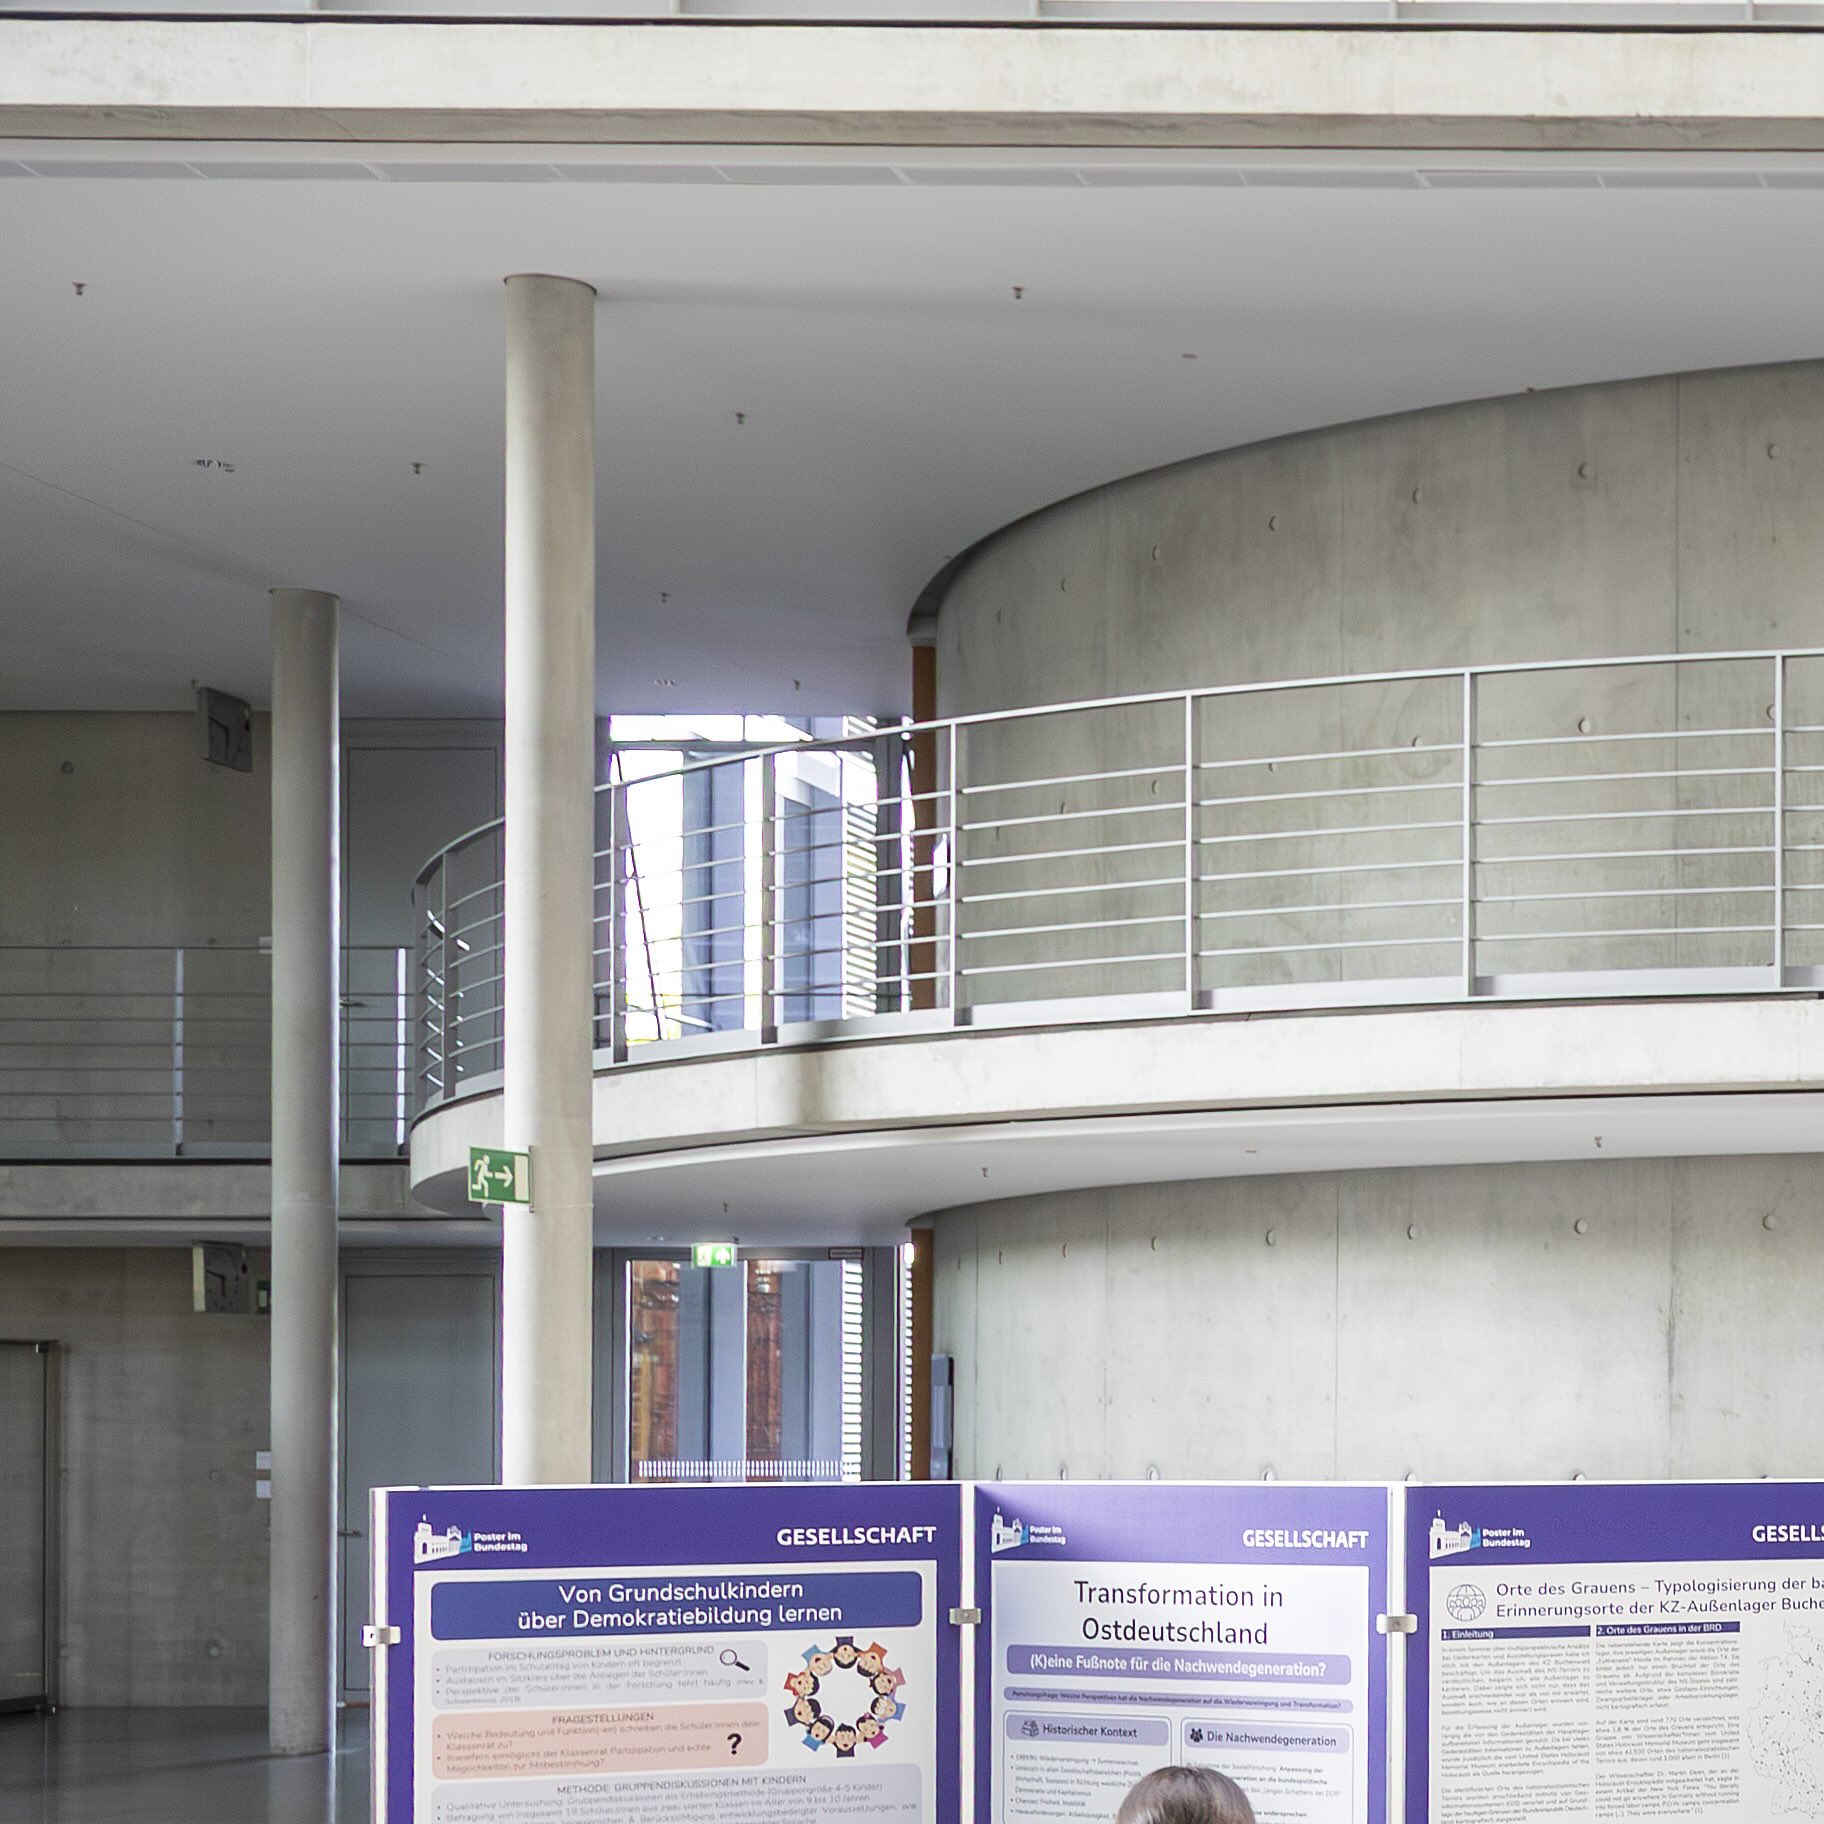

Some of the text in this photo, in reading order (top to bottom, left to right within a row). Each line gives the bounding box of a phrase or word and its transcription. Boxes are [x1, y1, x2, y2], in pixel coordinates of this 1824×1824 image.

[776, 1526, 937, 1546] GESELLSCHAFT
[1242, 1529, 1369, 1548] GESELLSCHAFT
[1482, 1527, 1525, 1537] Poster im
[1482, 1538, 1530, 1548] Bundestag
[558, 1580, 803, 1603] Von Grundschulkindern
[1073, 1580, 1282, 1607] Transformation in
[1496, 1583, 1532, 1596] Orte
[1538, 1582, 1565, 1595] des
[1571, 1581, 1635, 1594] Grauens
[1654, 1578, 1776, 1595] Typologisierung
[1781, 1577, 1806, 1590] der
[518, 1604, 842, 1630] über Demokratiebildung lernen
[1496, 1603, 1624, 1618] Erinnerungsorte
[1629, 1601, 1654, 1614] der
[1660, 1599, 1776, 1614] KZ-Außenlager
[1082, 1617, 1267, 1644] Ostdeutschland
[1030, 1653, 1327, 1679] (K)eine Fußnote für die Nachwendegeneration?
[1042, 1723, 1137, 1738] Historischer Kontext
[1207, 1730, 1336, 1746] Die Nachwendegeneration
